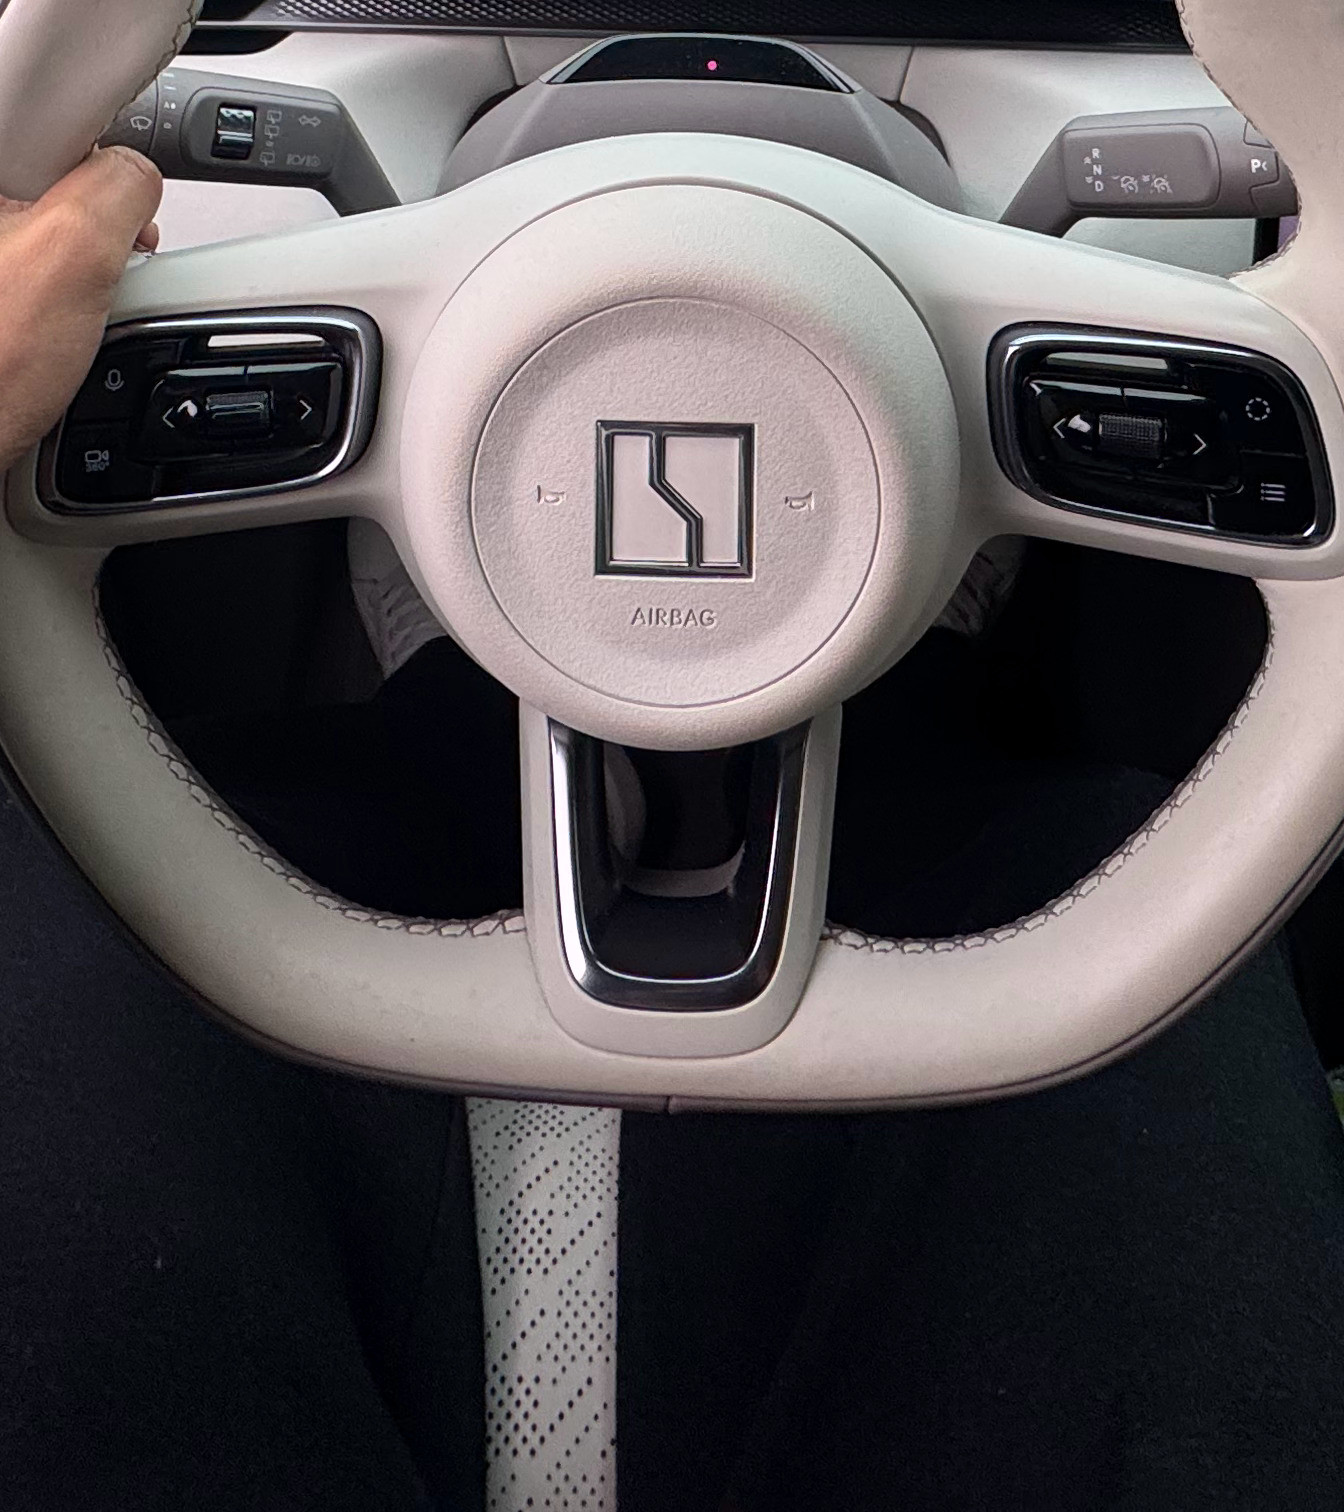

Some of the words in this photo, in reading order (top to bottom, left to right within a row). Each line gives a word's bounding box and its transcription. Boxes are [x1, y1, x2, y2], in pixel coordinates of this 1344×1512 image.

[1091, 148, 1100, 159] R
[1092, 164, 1102, 176] N
[1250, 158, 1261, 174] P
[1094, 180, 1104, 192] D
[631, 607, 716, 627] AIRBAG
